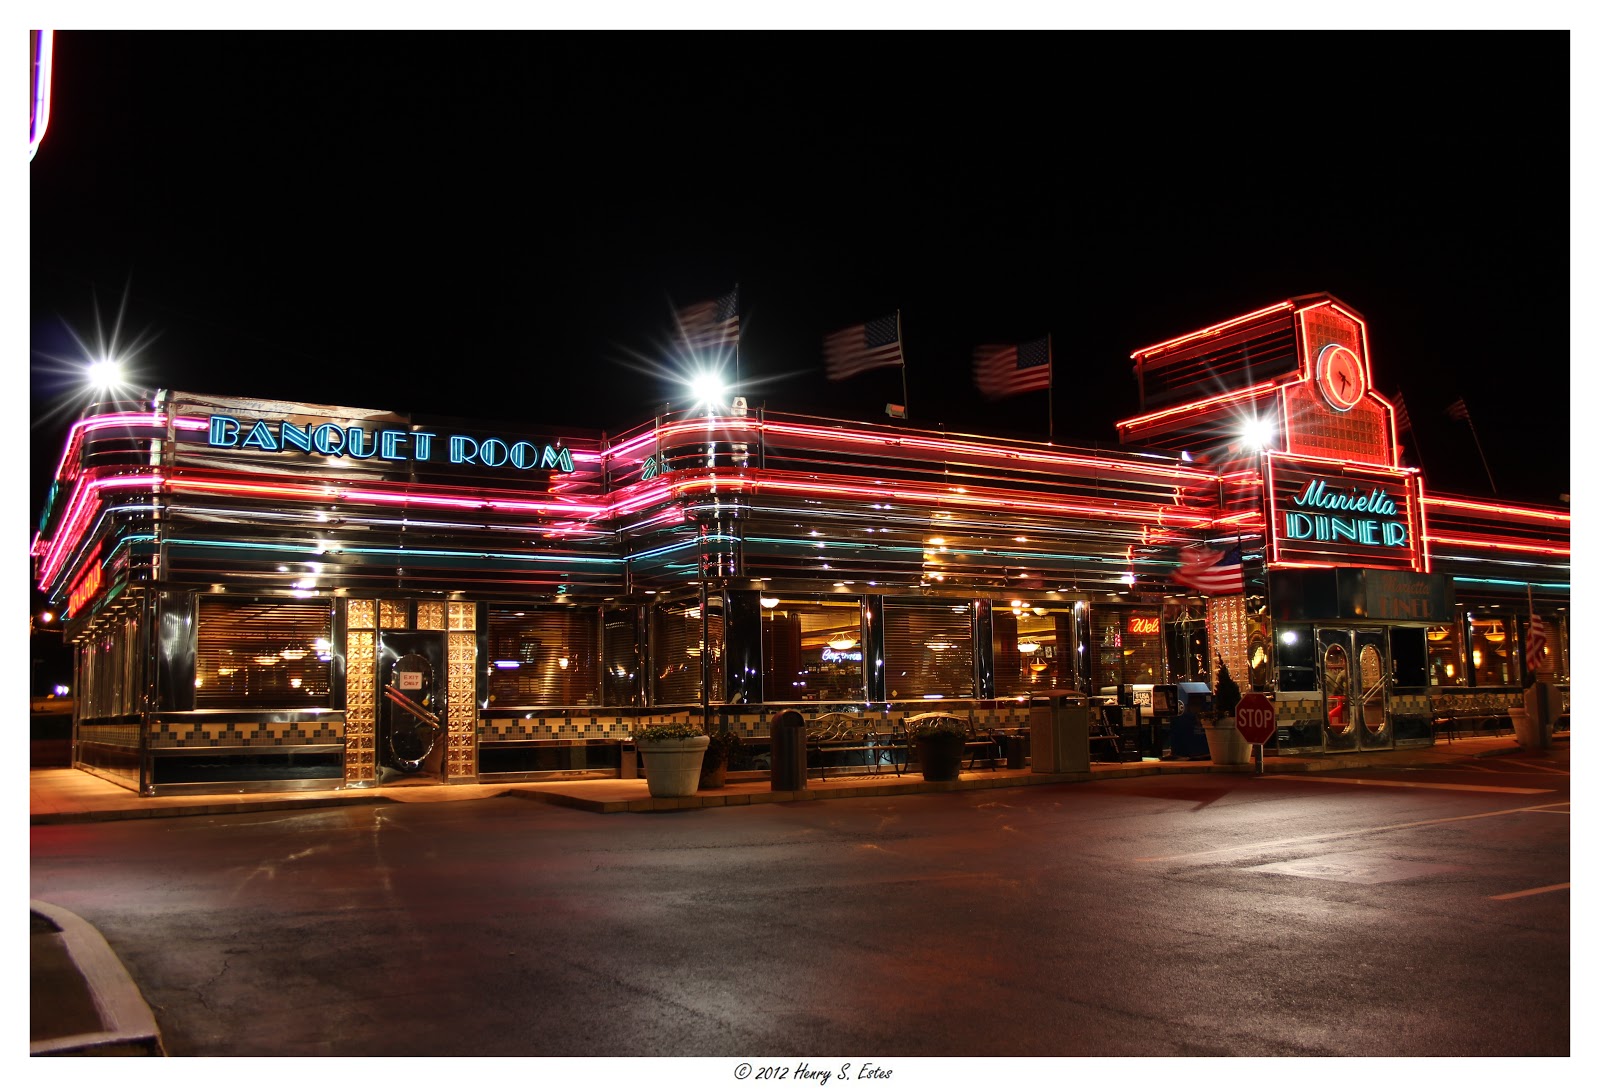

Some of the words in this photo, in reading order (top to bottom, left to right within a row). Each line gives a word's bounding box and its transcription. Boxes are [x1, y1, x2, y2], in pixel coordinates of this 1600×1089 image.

[208, 415, 437, 461] BANQUET
[449, 435, 575, 473] ROOM
[1293, 479, 1398, 516] Marietta
[1285, 513, 1407, 547] DINER
[1131, 618, 1160, 633] Wel
[1238, 708, 1272, 729] STOP
